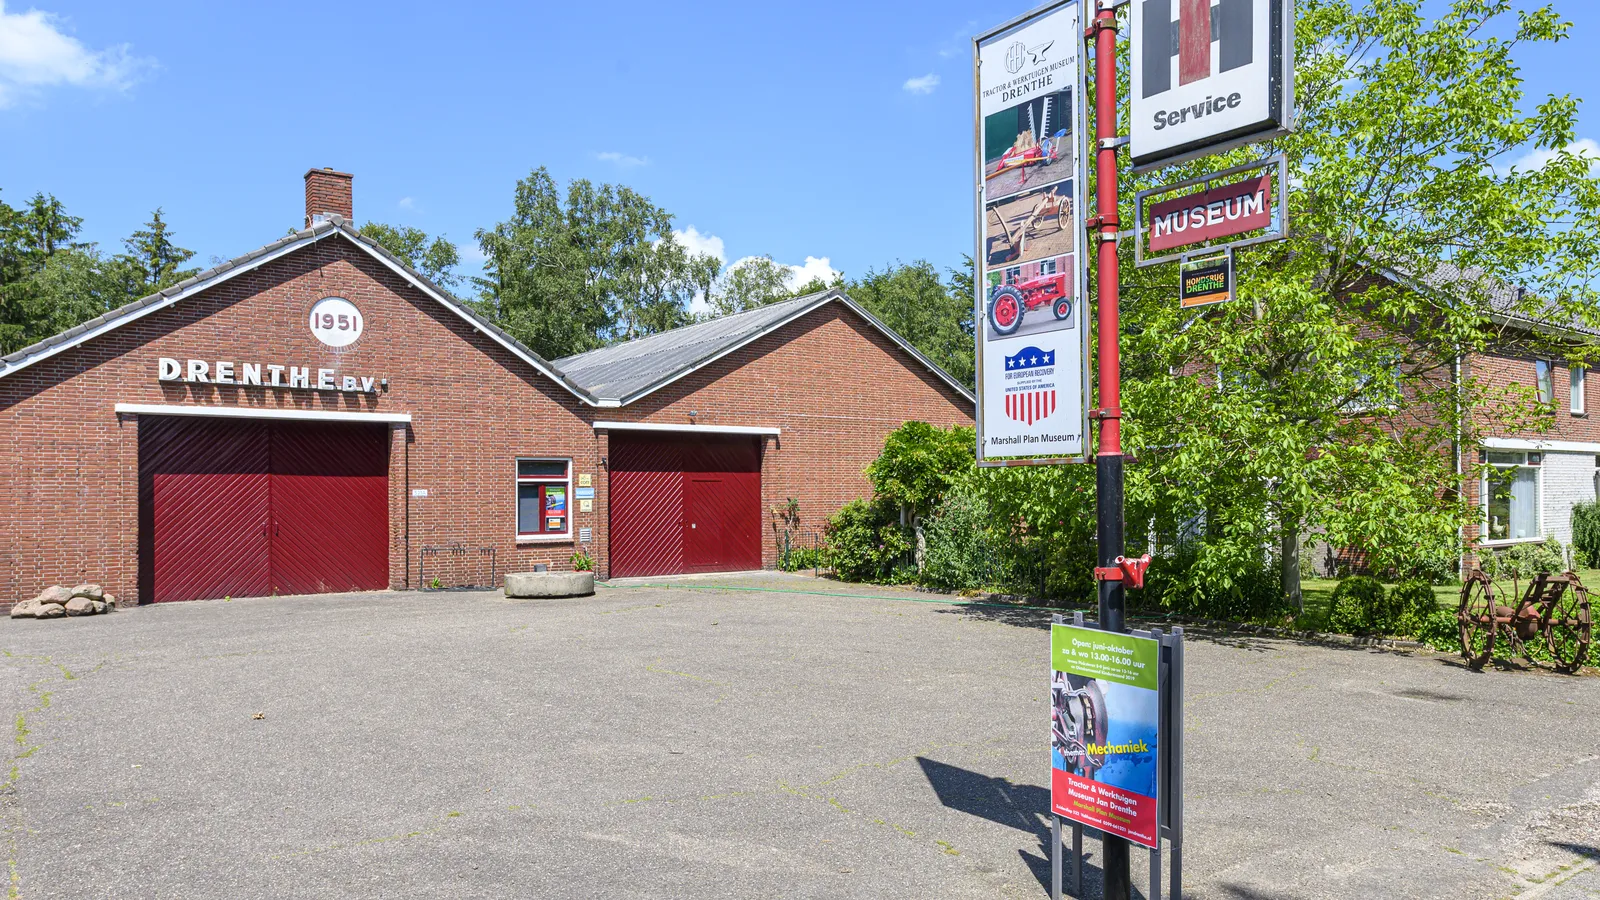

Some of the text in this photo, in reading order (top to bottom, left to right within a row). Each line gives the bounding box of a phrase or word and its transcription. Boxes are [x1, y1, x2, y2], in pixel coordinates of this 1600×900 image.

[982, 82, 1007, 98] TRACTOR
[1012, 66, 1049, 86] WERKTUIGEN
[1049, 56, 1075, 73] MUSEUM
[1002, 74, 1053, 102] DRENTHE
[1153, 92, 1242, 131] Service
[1154, 189, 1265, 238] MUSEUM
[1186, 272, 1225, 287] HONDSRUG
[1186, 281, 1225, 294] DRENTHE
[314, 312, 358, 332] 1951
[1005, 368, 1055, 380] FOR EUROPEAN RECOVERY
[991, 433, 1075, 445] Marshall Plan Museum
[1071, 637, 1134, 656] Open: juni-oktober
[1078, 651, 1089, 659] wo
[1090, 651, 1132, 667] 13.00-16.00
[1132, 660, 1146, 669] uur
[1087, 739, 1149, 756] Mechaniek
[1068, 777, 1138, 806] Tractor & Werktuigen
[1068, 788, 1138, 817] Museum Jan Drenthe
[1073, 800, 1131, 824] Marshall Plan Museum
